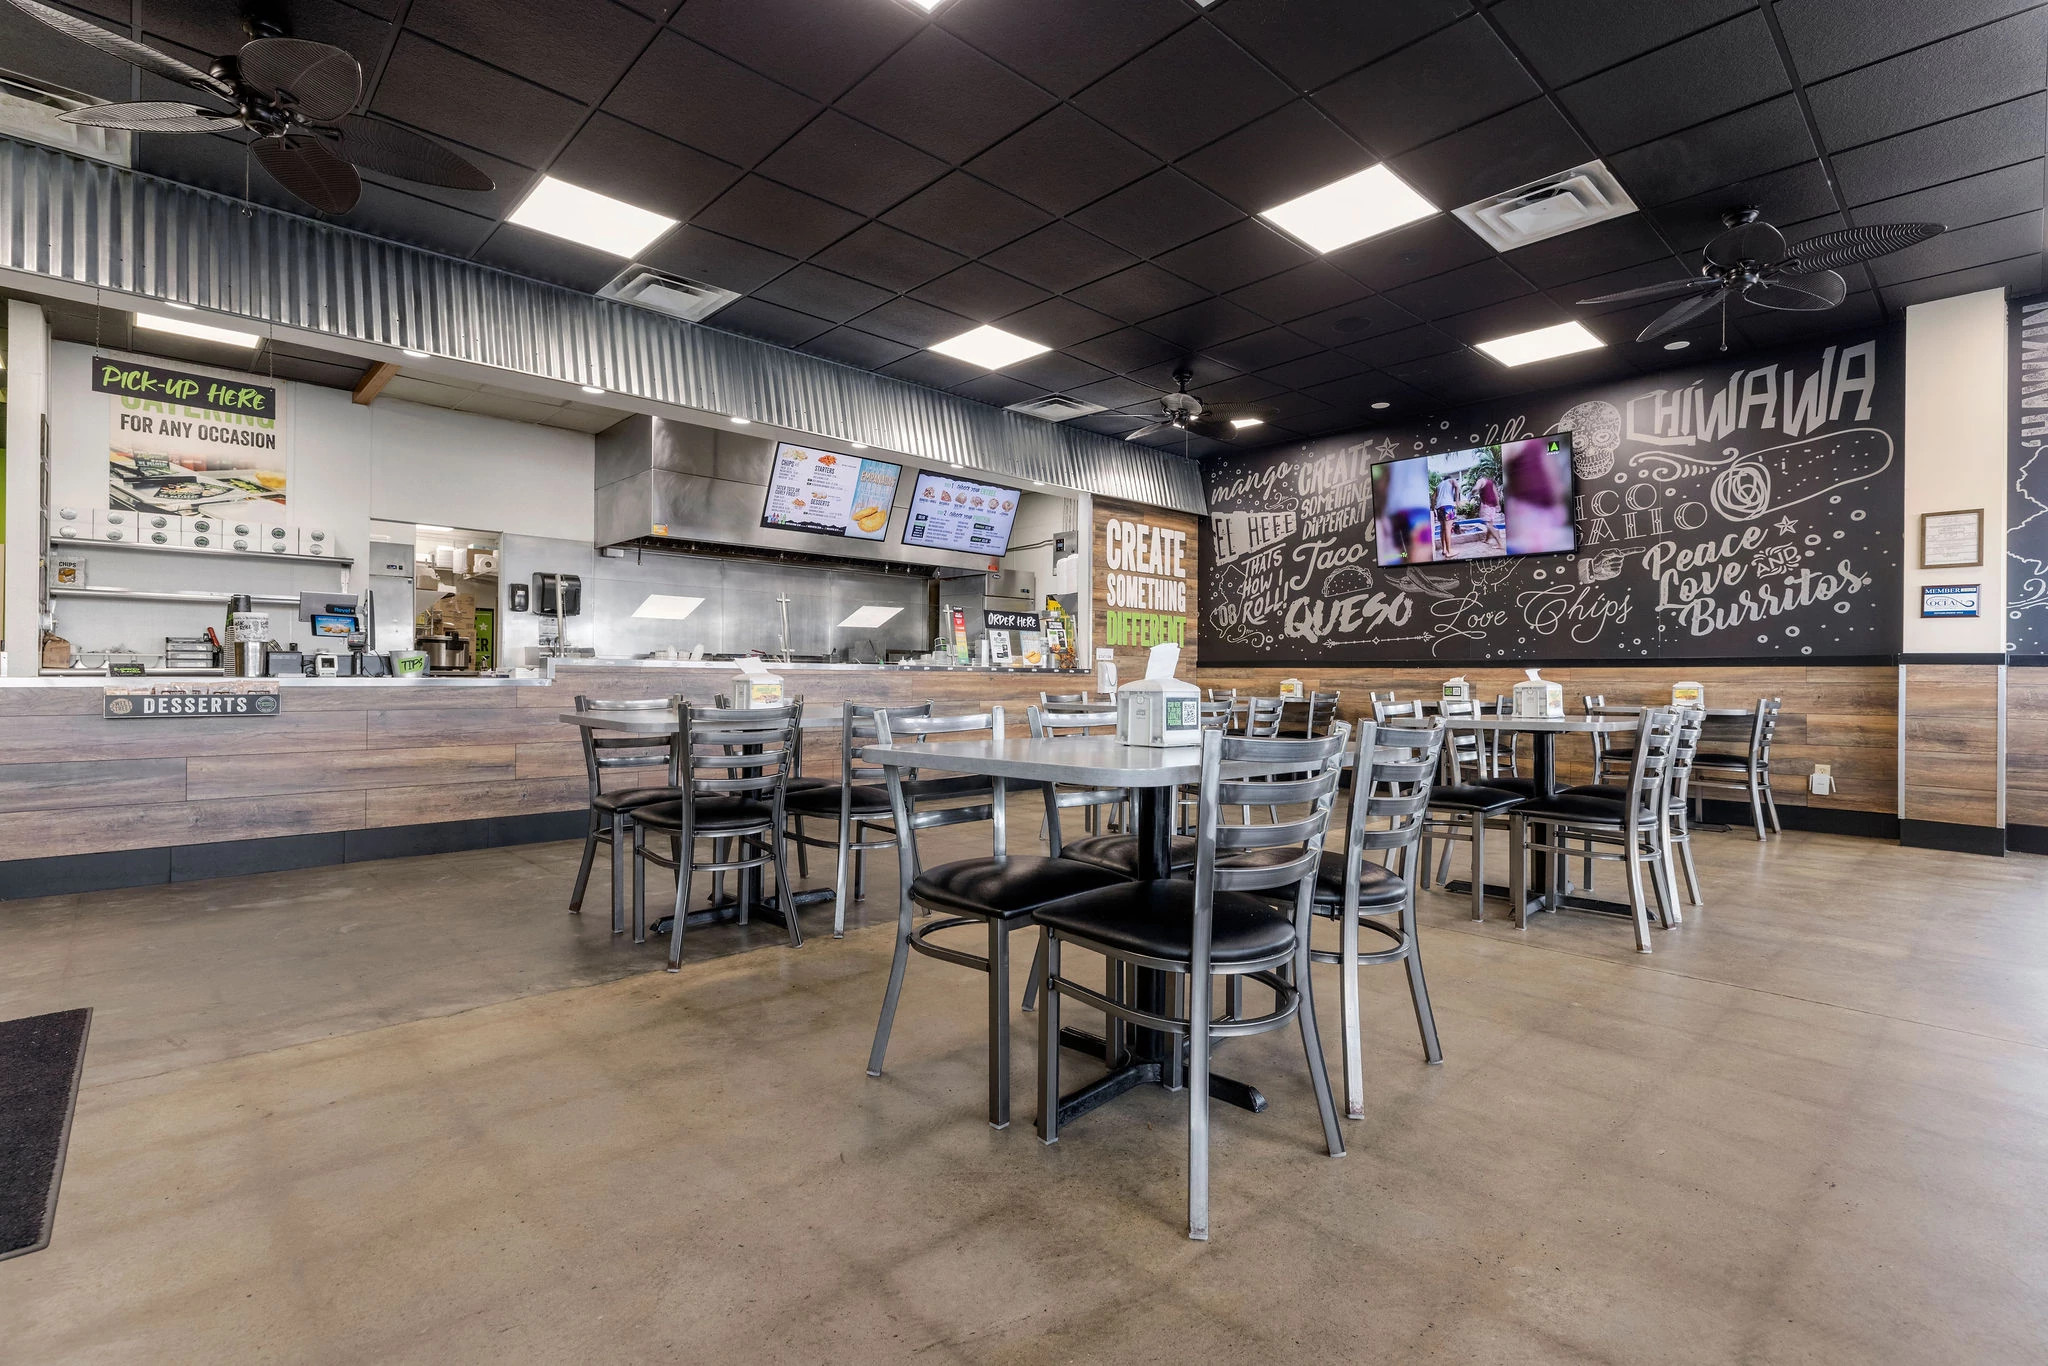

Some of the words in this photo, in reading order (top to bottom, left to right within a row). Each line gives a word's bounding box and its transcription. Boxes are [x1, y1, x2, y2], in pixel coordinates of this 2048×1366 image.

[102, 365, 199, 400] PICK-UP
[207, 383, 266, 411] HERE
[120, 413, 153, 434] FOR
[159, 419, 193, 438] ANY
[197, 424, 276, 449] OCCASION
[814, 465, 835, 475] STARTERS
[1211, 461, 1293, 505] mango
[1298, 439, 1374, 496] CREATE
[1574, 483, 1657, 521] ICO
[1576, 502, 1708, 546] ALLO
[1106, 518, 1186, 578] CREATE
[1214, 518, 1237, 560] EL
[1642, 526, 1768, 580] Peace
[1290, 536, 1368, 590] Taco
[1756, 546, 1799, 577] AND
[1106, 572, 1186, 613] SOMETHING
[1242, 575, 1272, 598] HOW
[1655, 562, 1748, 611] Love
[1678, 559, 1868, 636] Burritos
[988, 612, 1015, 626] ORDER
[1016, 616, 1037, 628] HERE
[1106, 610, 1187, 648] DIFFERENT
[1284, 591, 1413, 643] QUESO
[1430, 591, 1508, 657] Love
[1517, 584, 1633, 643] Chips
[400, 656, 423, 672] TIPS
[143, 697, 247, 714] DESSERTS
